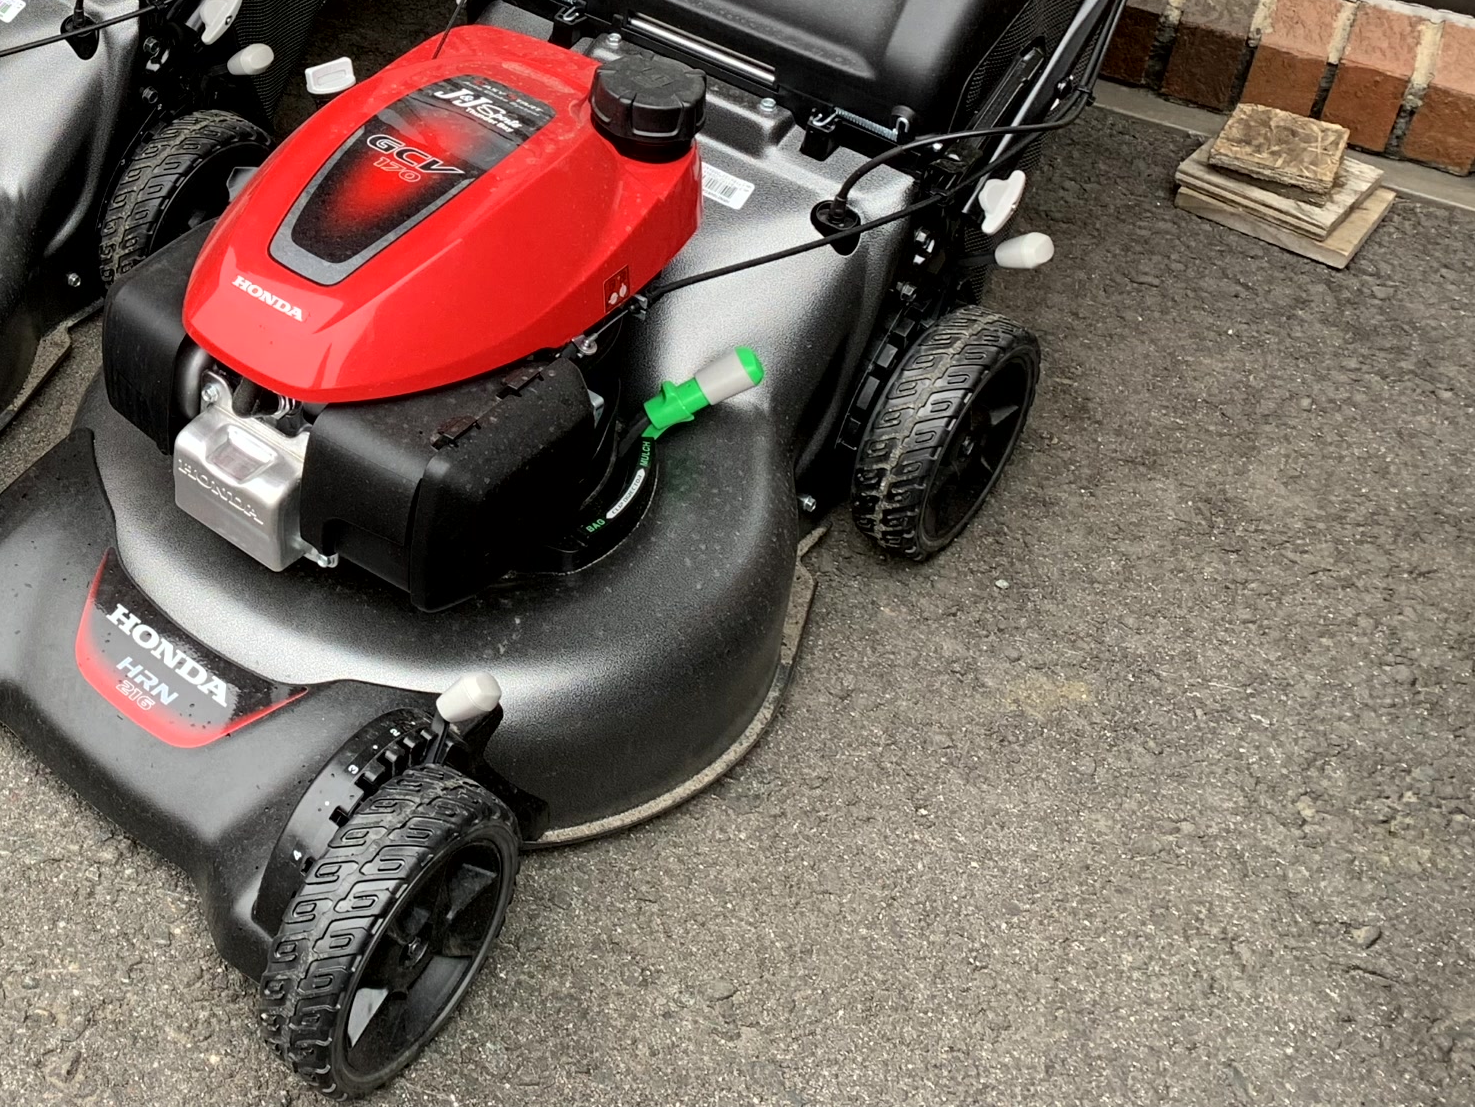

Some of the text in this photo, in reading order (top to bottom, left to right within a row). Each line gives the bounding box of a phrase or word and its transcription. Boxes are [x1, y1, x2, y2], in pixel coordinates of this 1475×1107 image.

[466, 107, 514, 133] Thunder Bay
[367, 134, 466, 174] GCV
[373, 157, 421, 182] 170
[231, 275, 303, 322] HONDA
[639, 441, 651, 467] MULCH
[178, 459, 264, 525] HONDA
[585, 518, 605, 533] BAG
[106, 603, 227, 707] HONDA
[116, 656, 179, 705] HRN
[116, 680, 156, 711] 216
[348, 764, 359, 774] 3
